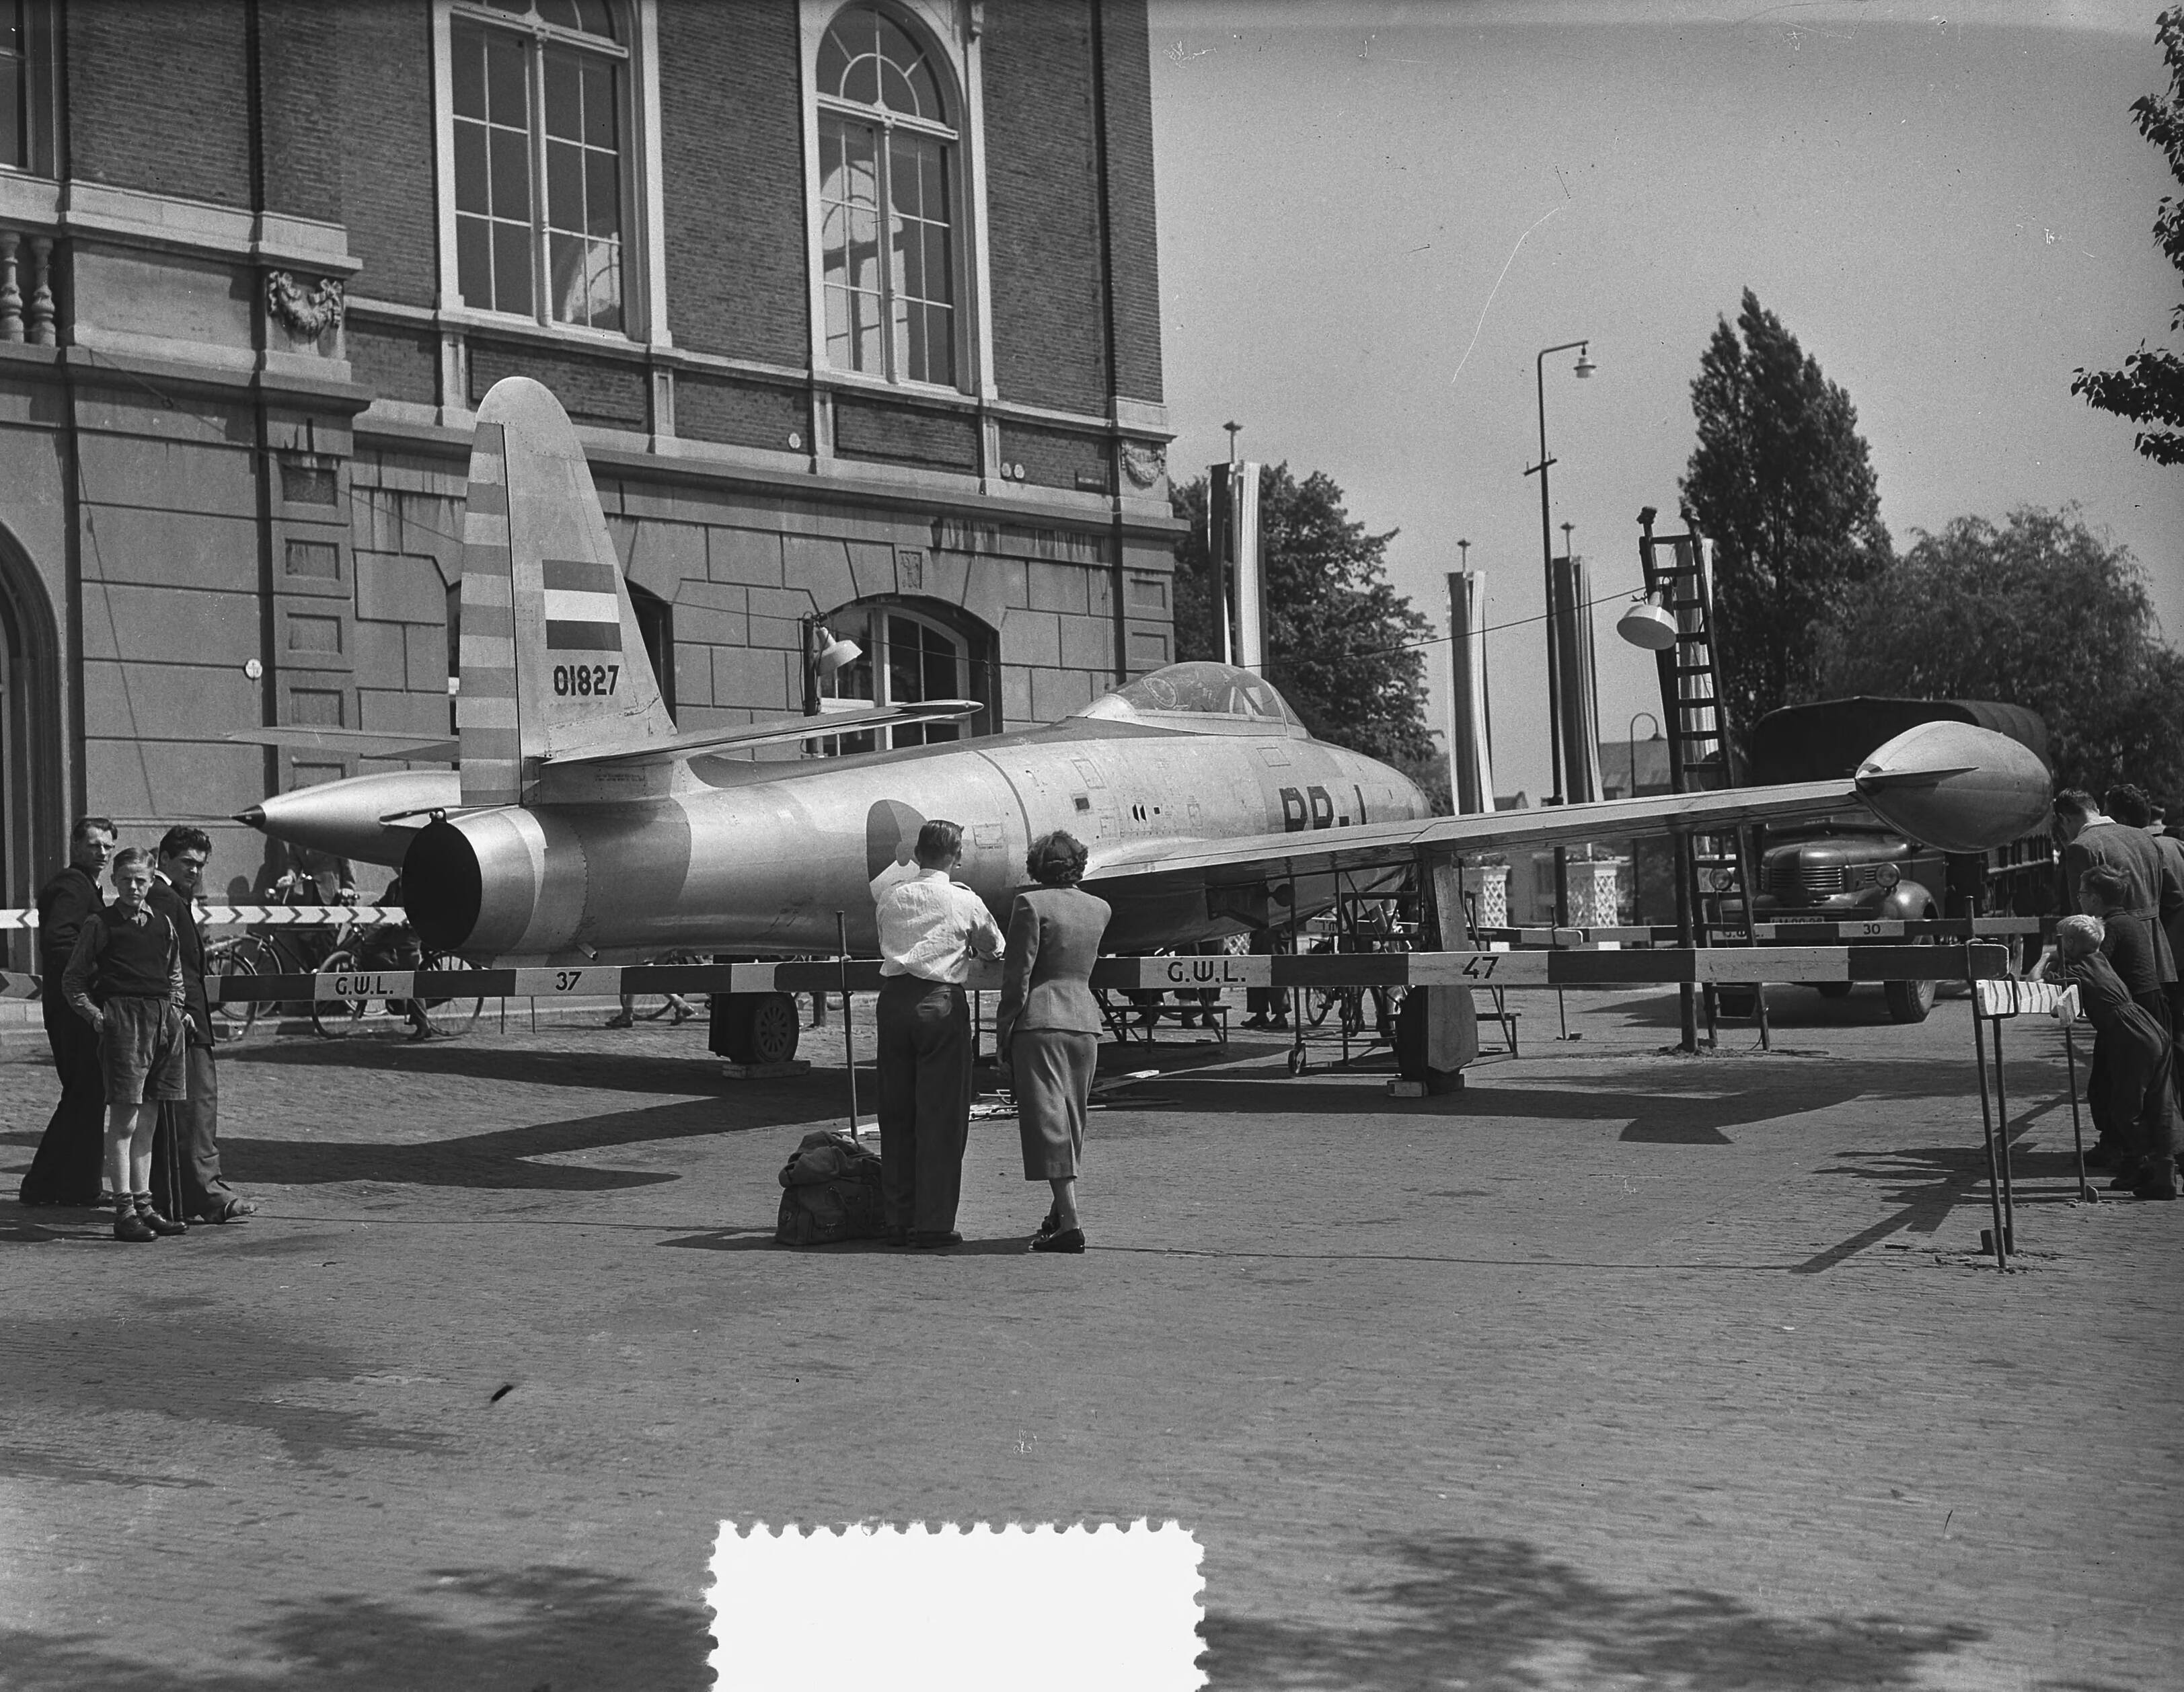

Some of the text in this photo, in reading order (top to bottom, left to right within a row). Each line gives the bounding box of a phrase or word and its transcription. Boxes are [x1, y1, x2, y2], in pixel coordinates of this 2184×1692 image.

[553, 664, 619, 696] 01827
[1862, 923, 1881, 935] 30
[1167, 960, 1246, 983] G.W.L.
[1462, 956, 1499, 980] 47
[335, 976, 394, 996] G.W.L.
[555, 970, 582, 991] 37
